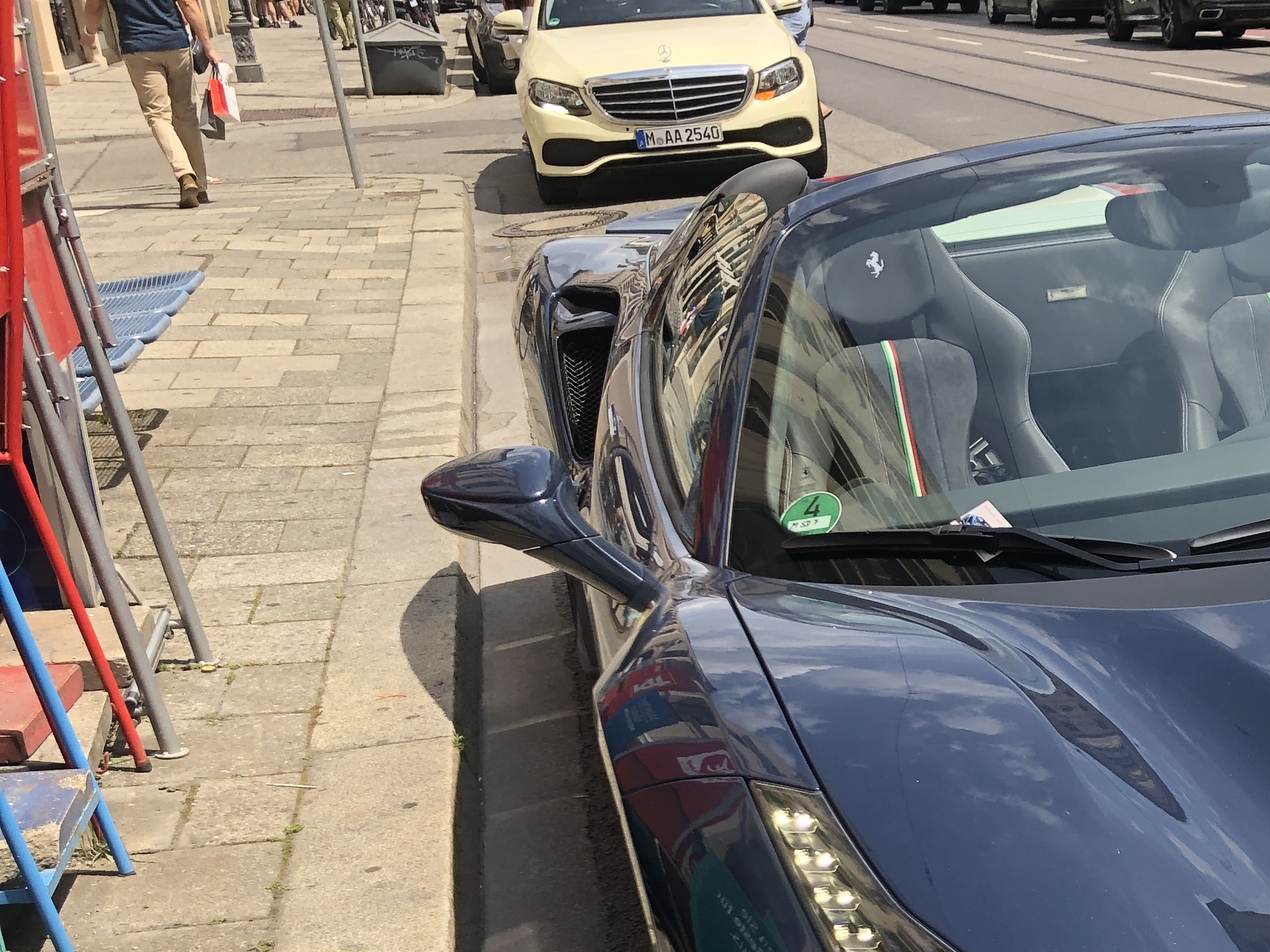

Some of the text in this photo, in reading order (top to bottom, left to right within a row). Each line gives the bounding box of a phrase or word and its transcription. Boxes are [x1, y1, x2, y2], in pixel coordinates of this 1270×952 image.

[645, 126, 720, 146] M AA 2540
[803, 495, 820, 517] 4
